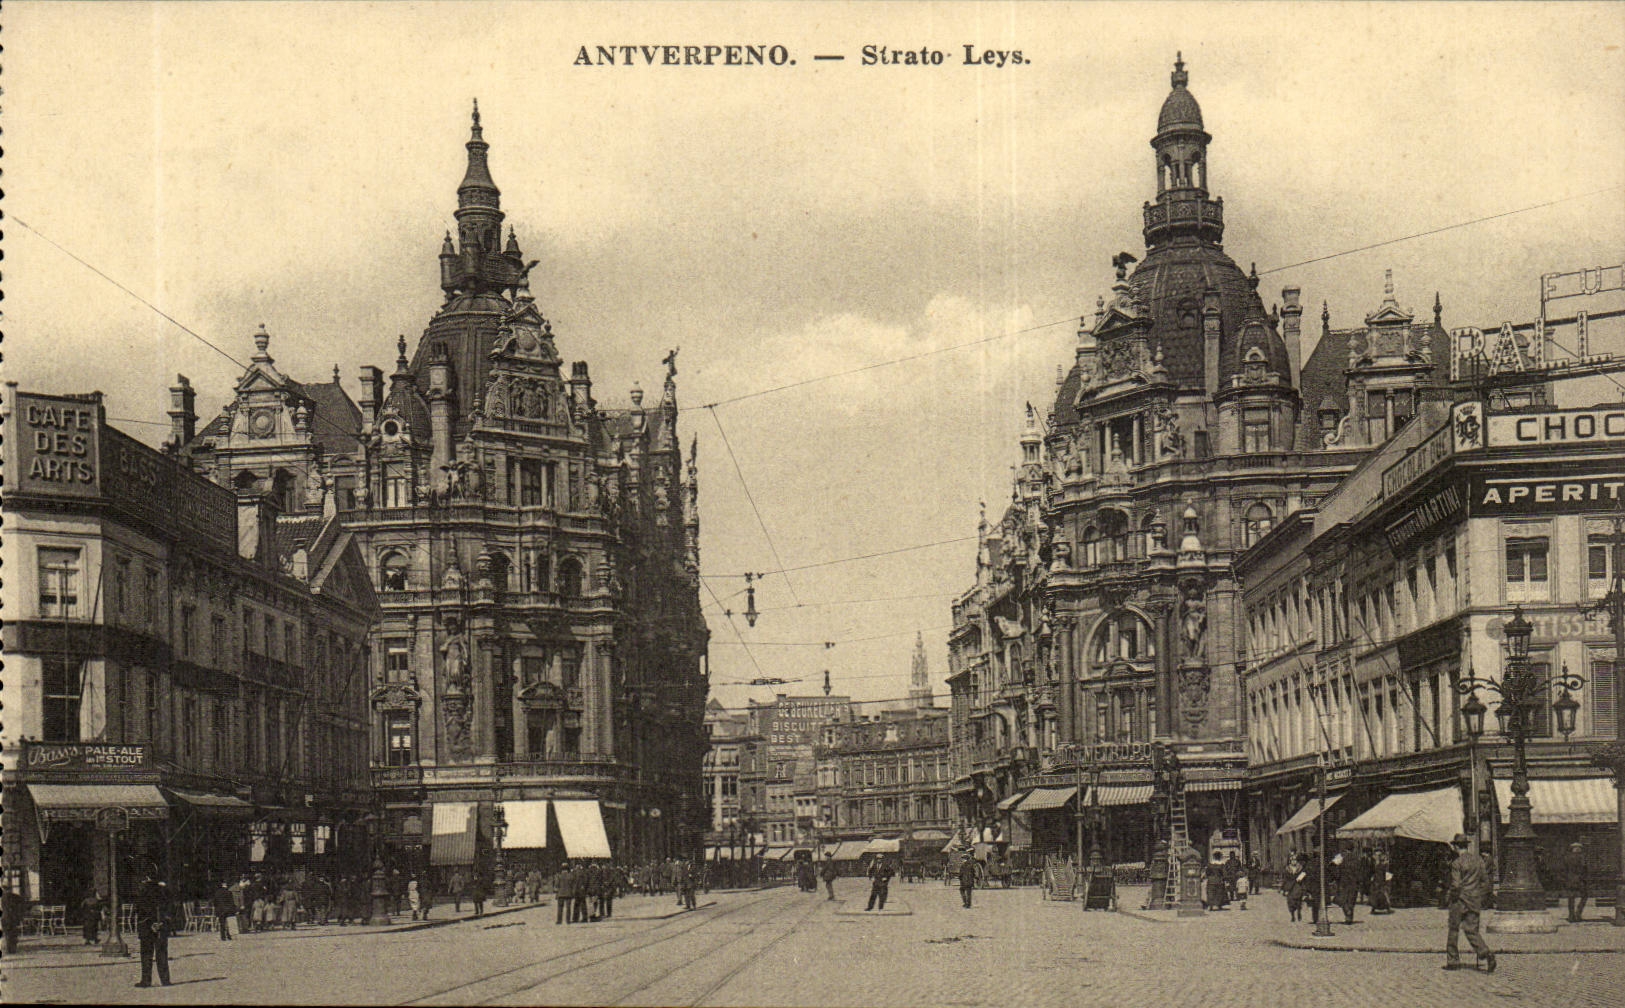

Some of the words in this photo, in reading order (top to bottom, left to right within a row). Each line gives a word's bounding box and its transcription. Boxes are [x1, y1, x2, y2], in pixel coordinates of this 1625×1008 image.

[27, 405, 91, 432] CAFE
[1516, 413, 1625, 441] CHOC
[34, 431, 87, 457] DES
[30, 457, 94, 484] ARTS
[1482, 482, 1625, 504] APERIT
[1415, 485, 1461, 528] MARTINI
[84, 746, 144, 755] PALE-ALE
[770, 734, 801, 743] BEST
[105, 755, 143, 764] STOUT
